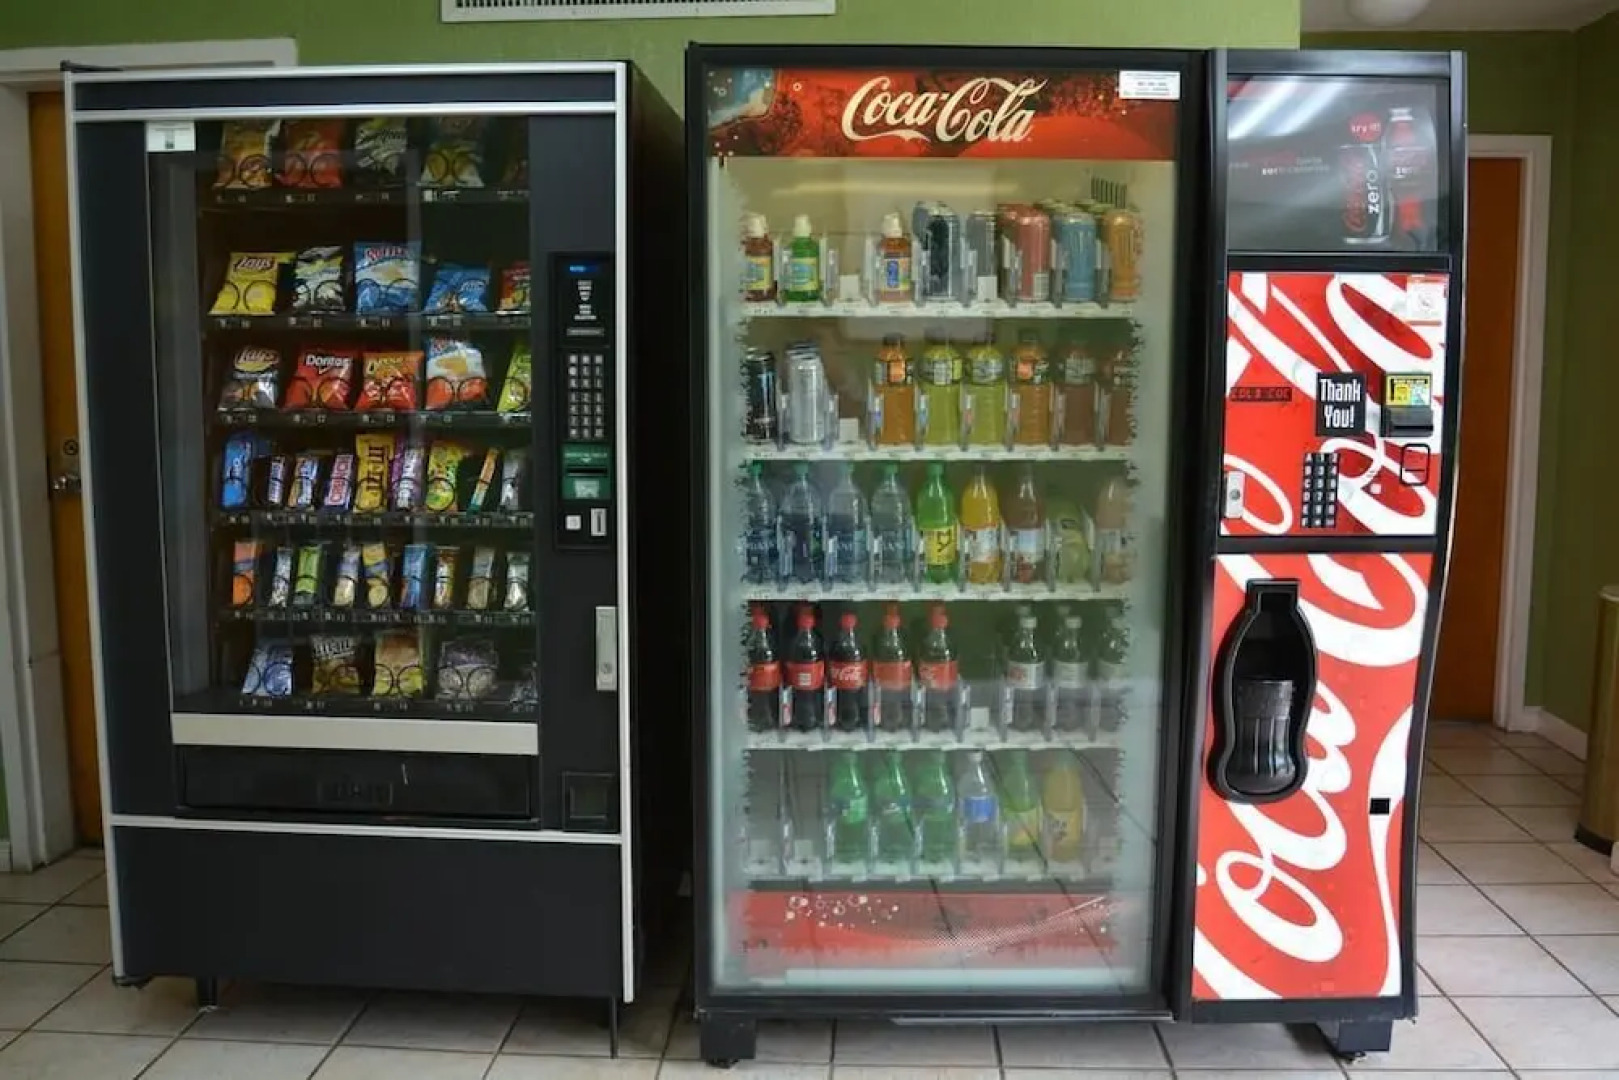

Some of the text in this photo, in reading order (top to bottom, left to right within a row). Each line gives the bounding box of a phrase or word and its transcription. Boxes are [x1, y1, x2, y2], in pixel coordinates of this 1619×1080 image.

[841, 76, 1049, 142] Coca-Cola
[1366, 169, 1379, 214] zero
[305, 354, 353, 370] Doritos
[1320, 379, 1361, 401] Thank
[1323, 405, 1355, 428] You!
